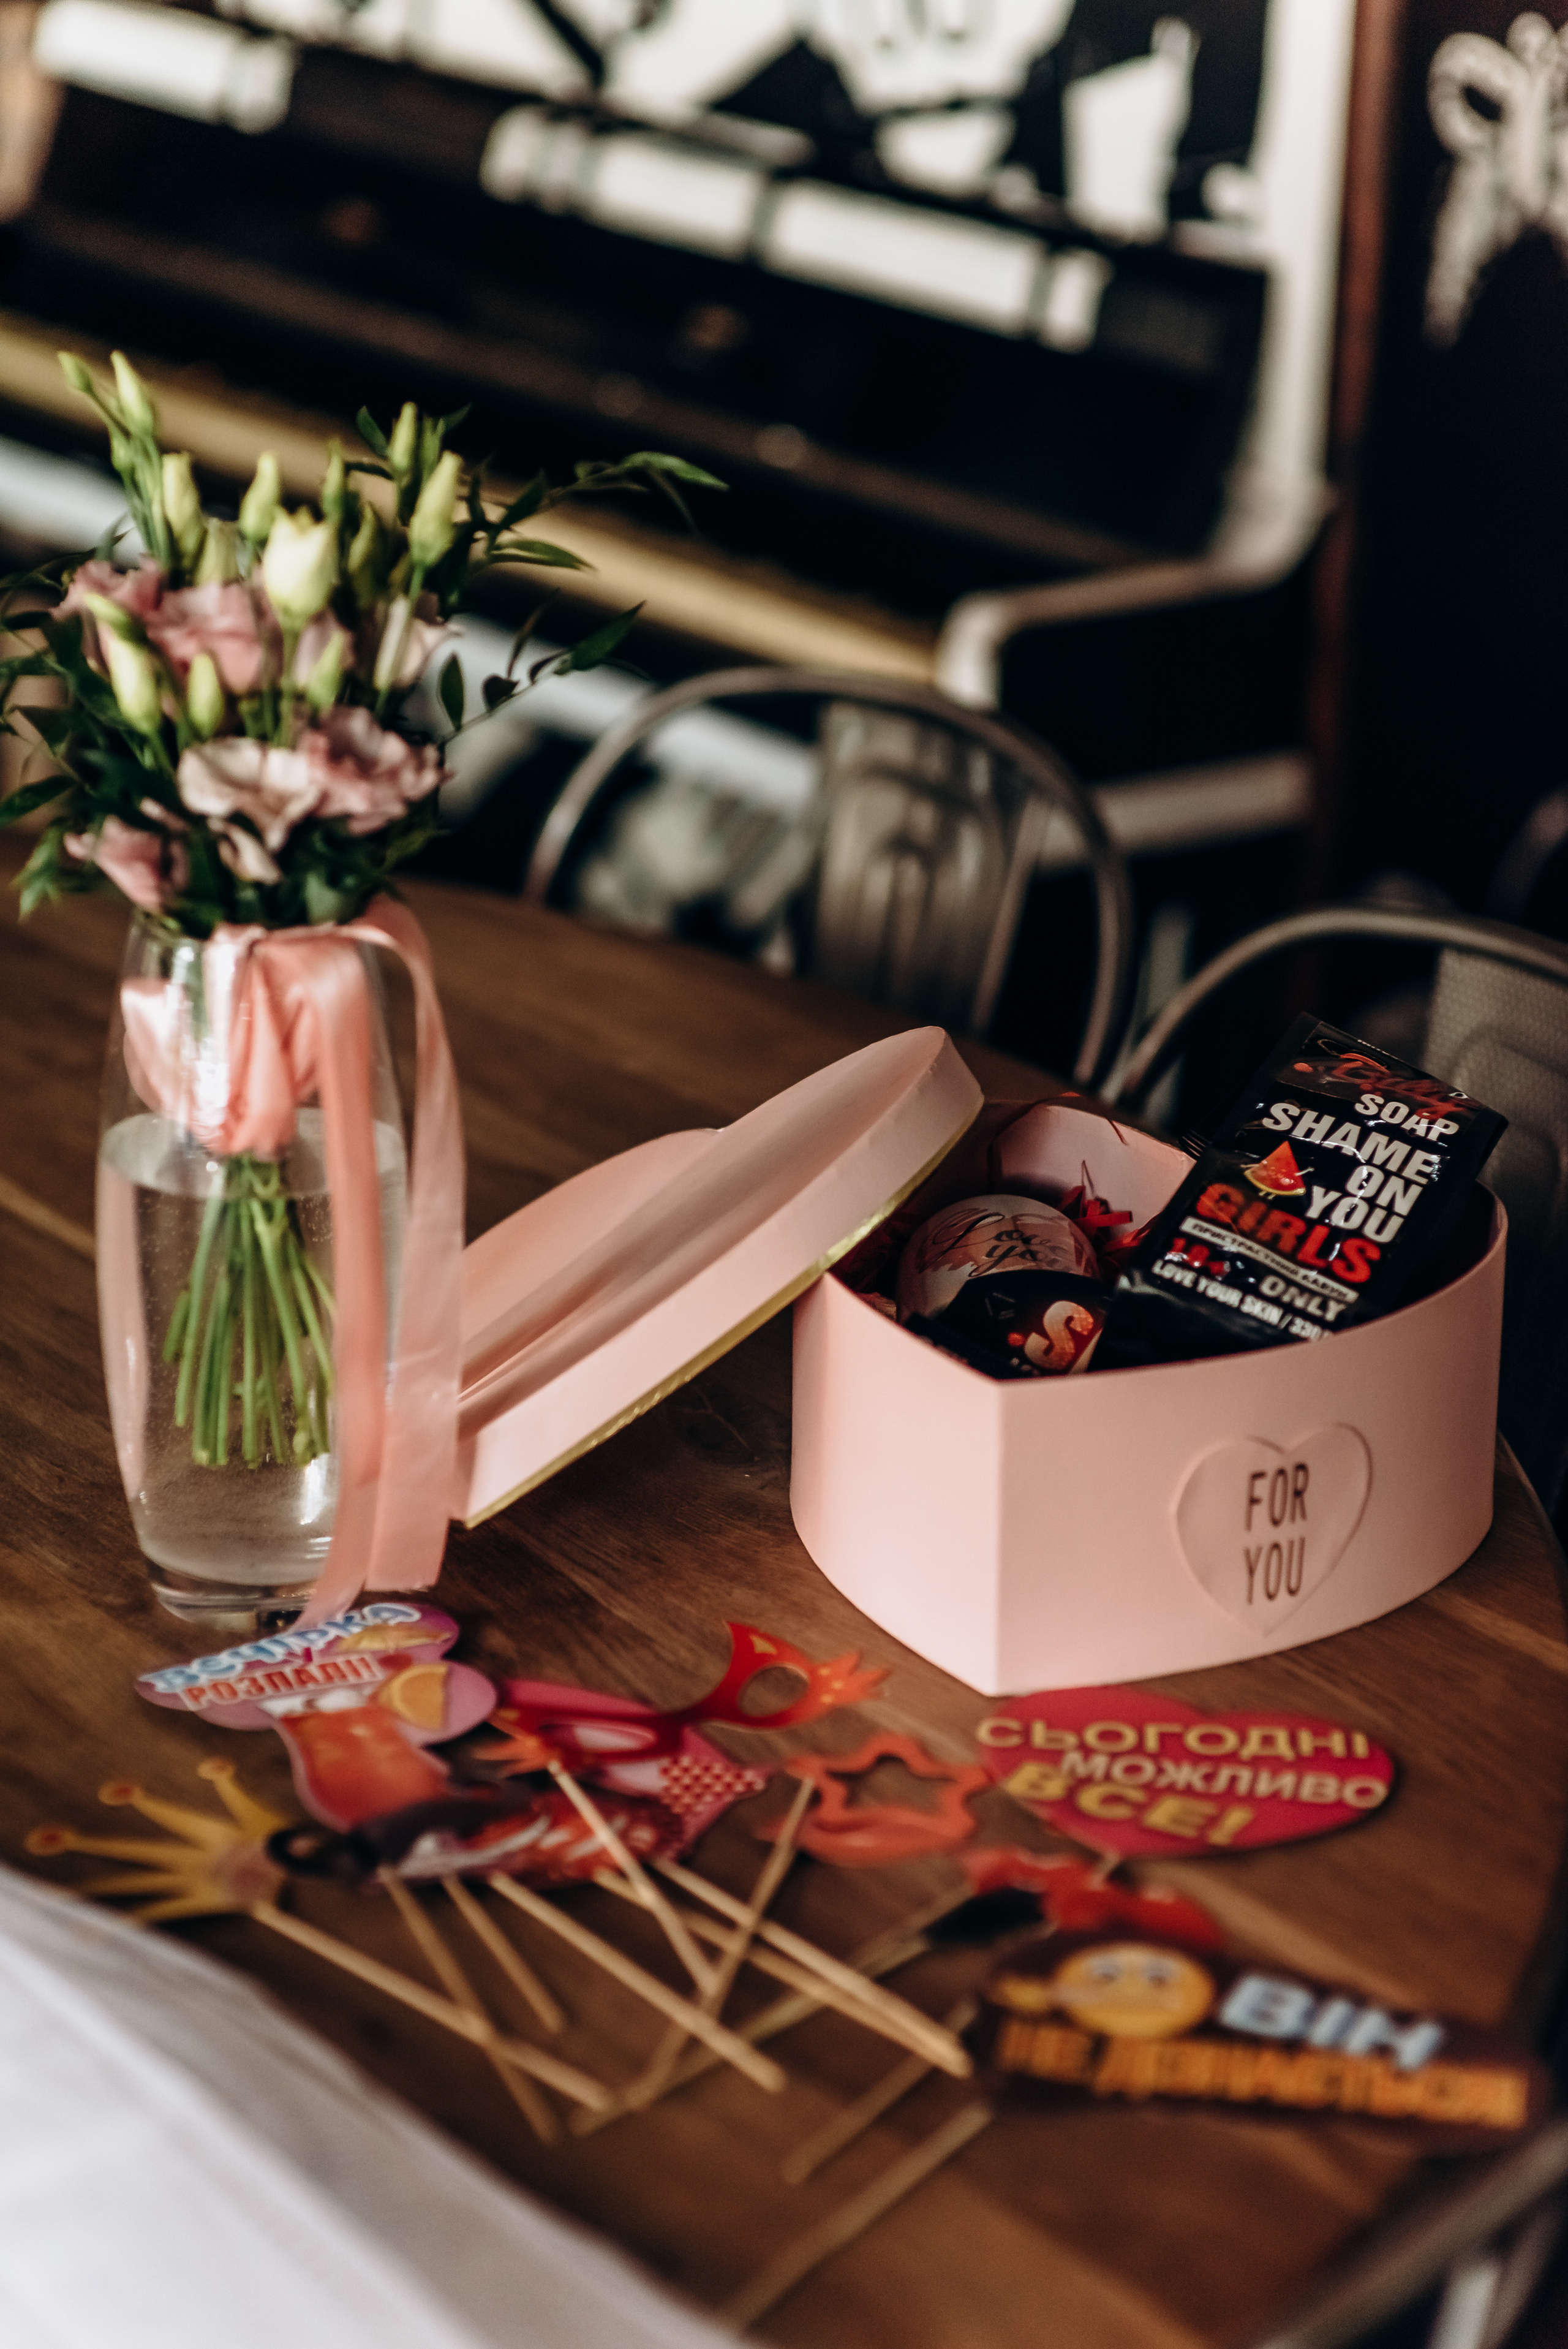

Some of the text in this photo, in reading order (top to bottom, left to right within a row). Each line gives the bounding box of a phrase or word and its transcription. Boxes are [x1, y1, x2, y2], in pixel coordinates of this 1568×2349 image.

[1262, 1103, 1435, 1184] SHAME
[1354, 1094, 1460, 1141] SOAP
[1305, 1186, 1404, 1243] YOU
[1346, 1165, 1423, 1216] ON
[1196, 1183, 1381, 1283] GIRLS
[1152, 1259, 1197, 1288] LOVE
[1196, 1276, 1243, 1307] YOUR
[1240, 1295, 1283, 1325] SKIN
[1259, 1275, 1346, 1322] ONLY
[1245, 1462, 1310, 1532] FOR
[1243, 1535, 1306, 1605] YOU
[978, 1717, 1371, 1760] СЬОГОДНІ
[1060, 1750, 1388, 1809] МОЖЛИВО
[1221, 1974, 1446, 2070] ВІН
